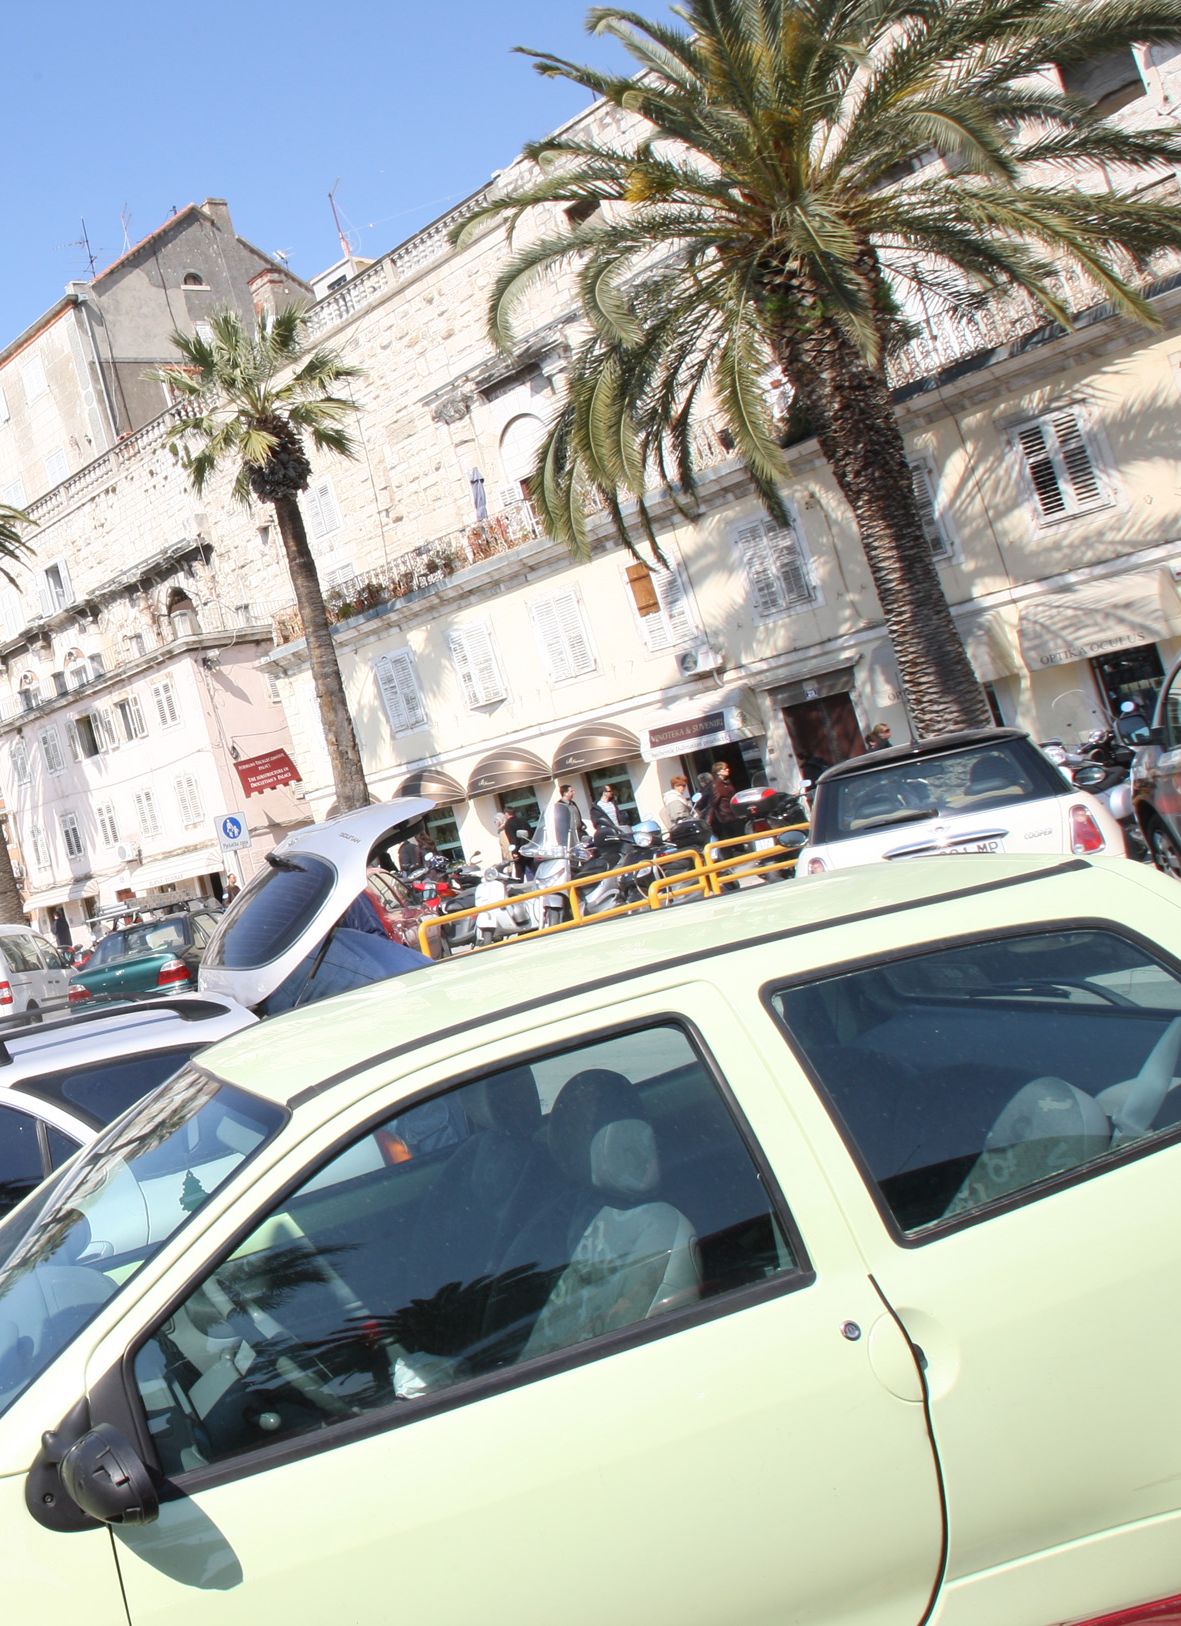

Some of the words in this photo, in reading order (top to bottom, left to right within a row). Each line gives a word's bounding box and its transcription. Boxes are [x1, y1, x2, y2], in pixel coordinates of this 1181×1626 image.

[1039, 647, 1088, 665] OPTIKA
[1090, 631, 1145, 653] OCULUS
[651, 728, 685, 743] VINOTEKA
[685, 727, 691, 735] &
[1023, 827, 1054, 840] COOPER
